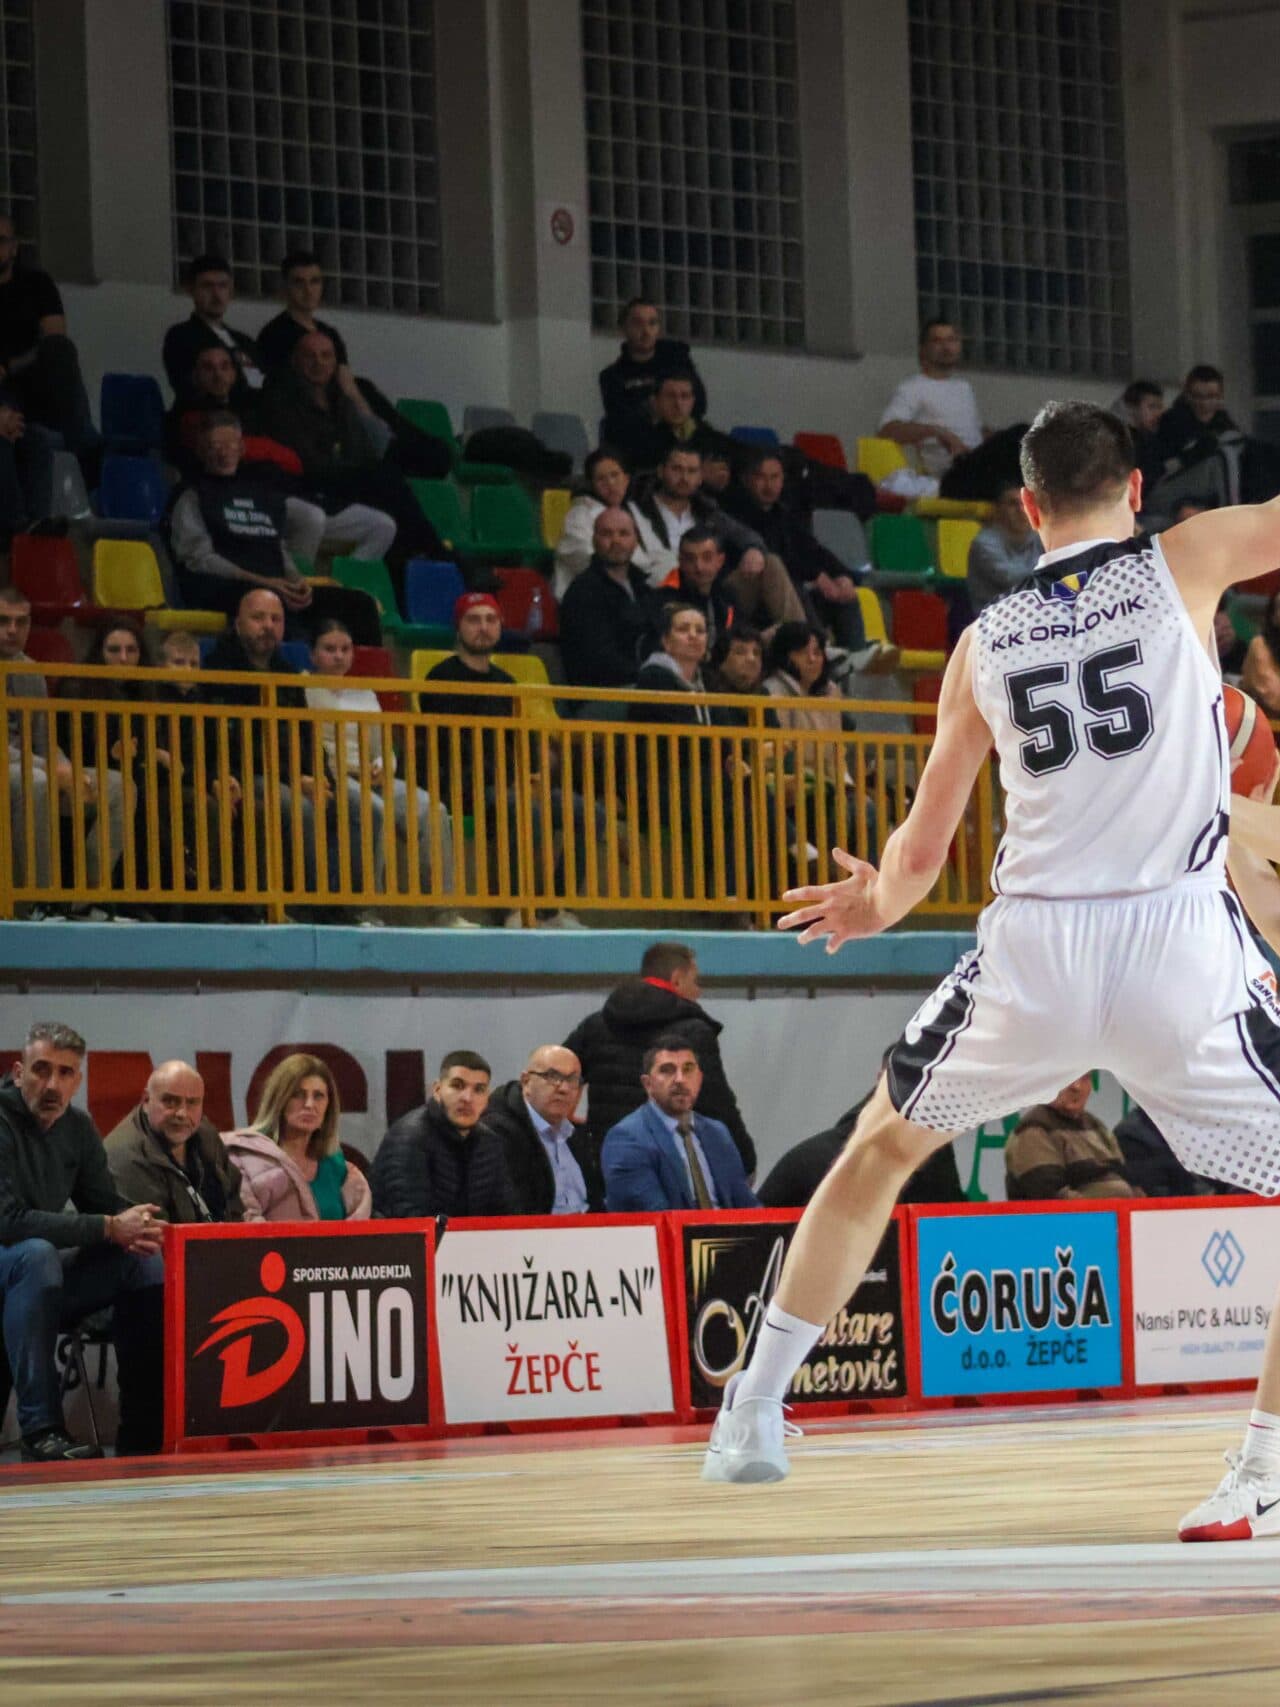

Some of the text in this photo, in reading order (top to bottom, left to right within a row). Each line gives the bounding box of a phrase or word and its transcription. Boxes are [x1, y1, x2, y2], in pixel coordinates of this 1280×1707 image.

[991, 595, 1145, 652] KK ORLOVIK
[1003, 638, 1155, 778] 55
[293, 1264, 412, 1283] SPORTSKA AKADEMIJA
[930, 1245, 1112, 1335] ĆORUŠA
[1136, 1310, 1174, 1331] Nansi
[1178, 1308, 1206, 1328] PVC
[1210, 1307, 1220, 1327] &
[1224, 1306, 1251, 1327] ALU
[505, 1340, 602, 1396] ŽEPČE
[961, 1333, 1088, 1371] d.o.o. ŽEPČE
